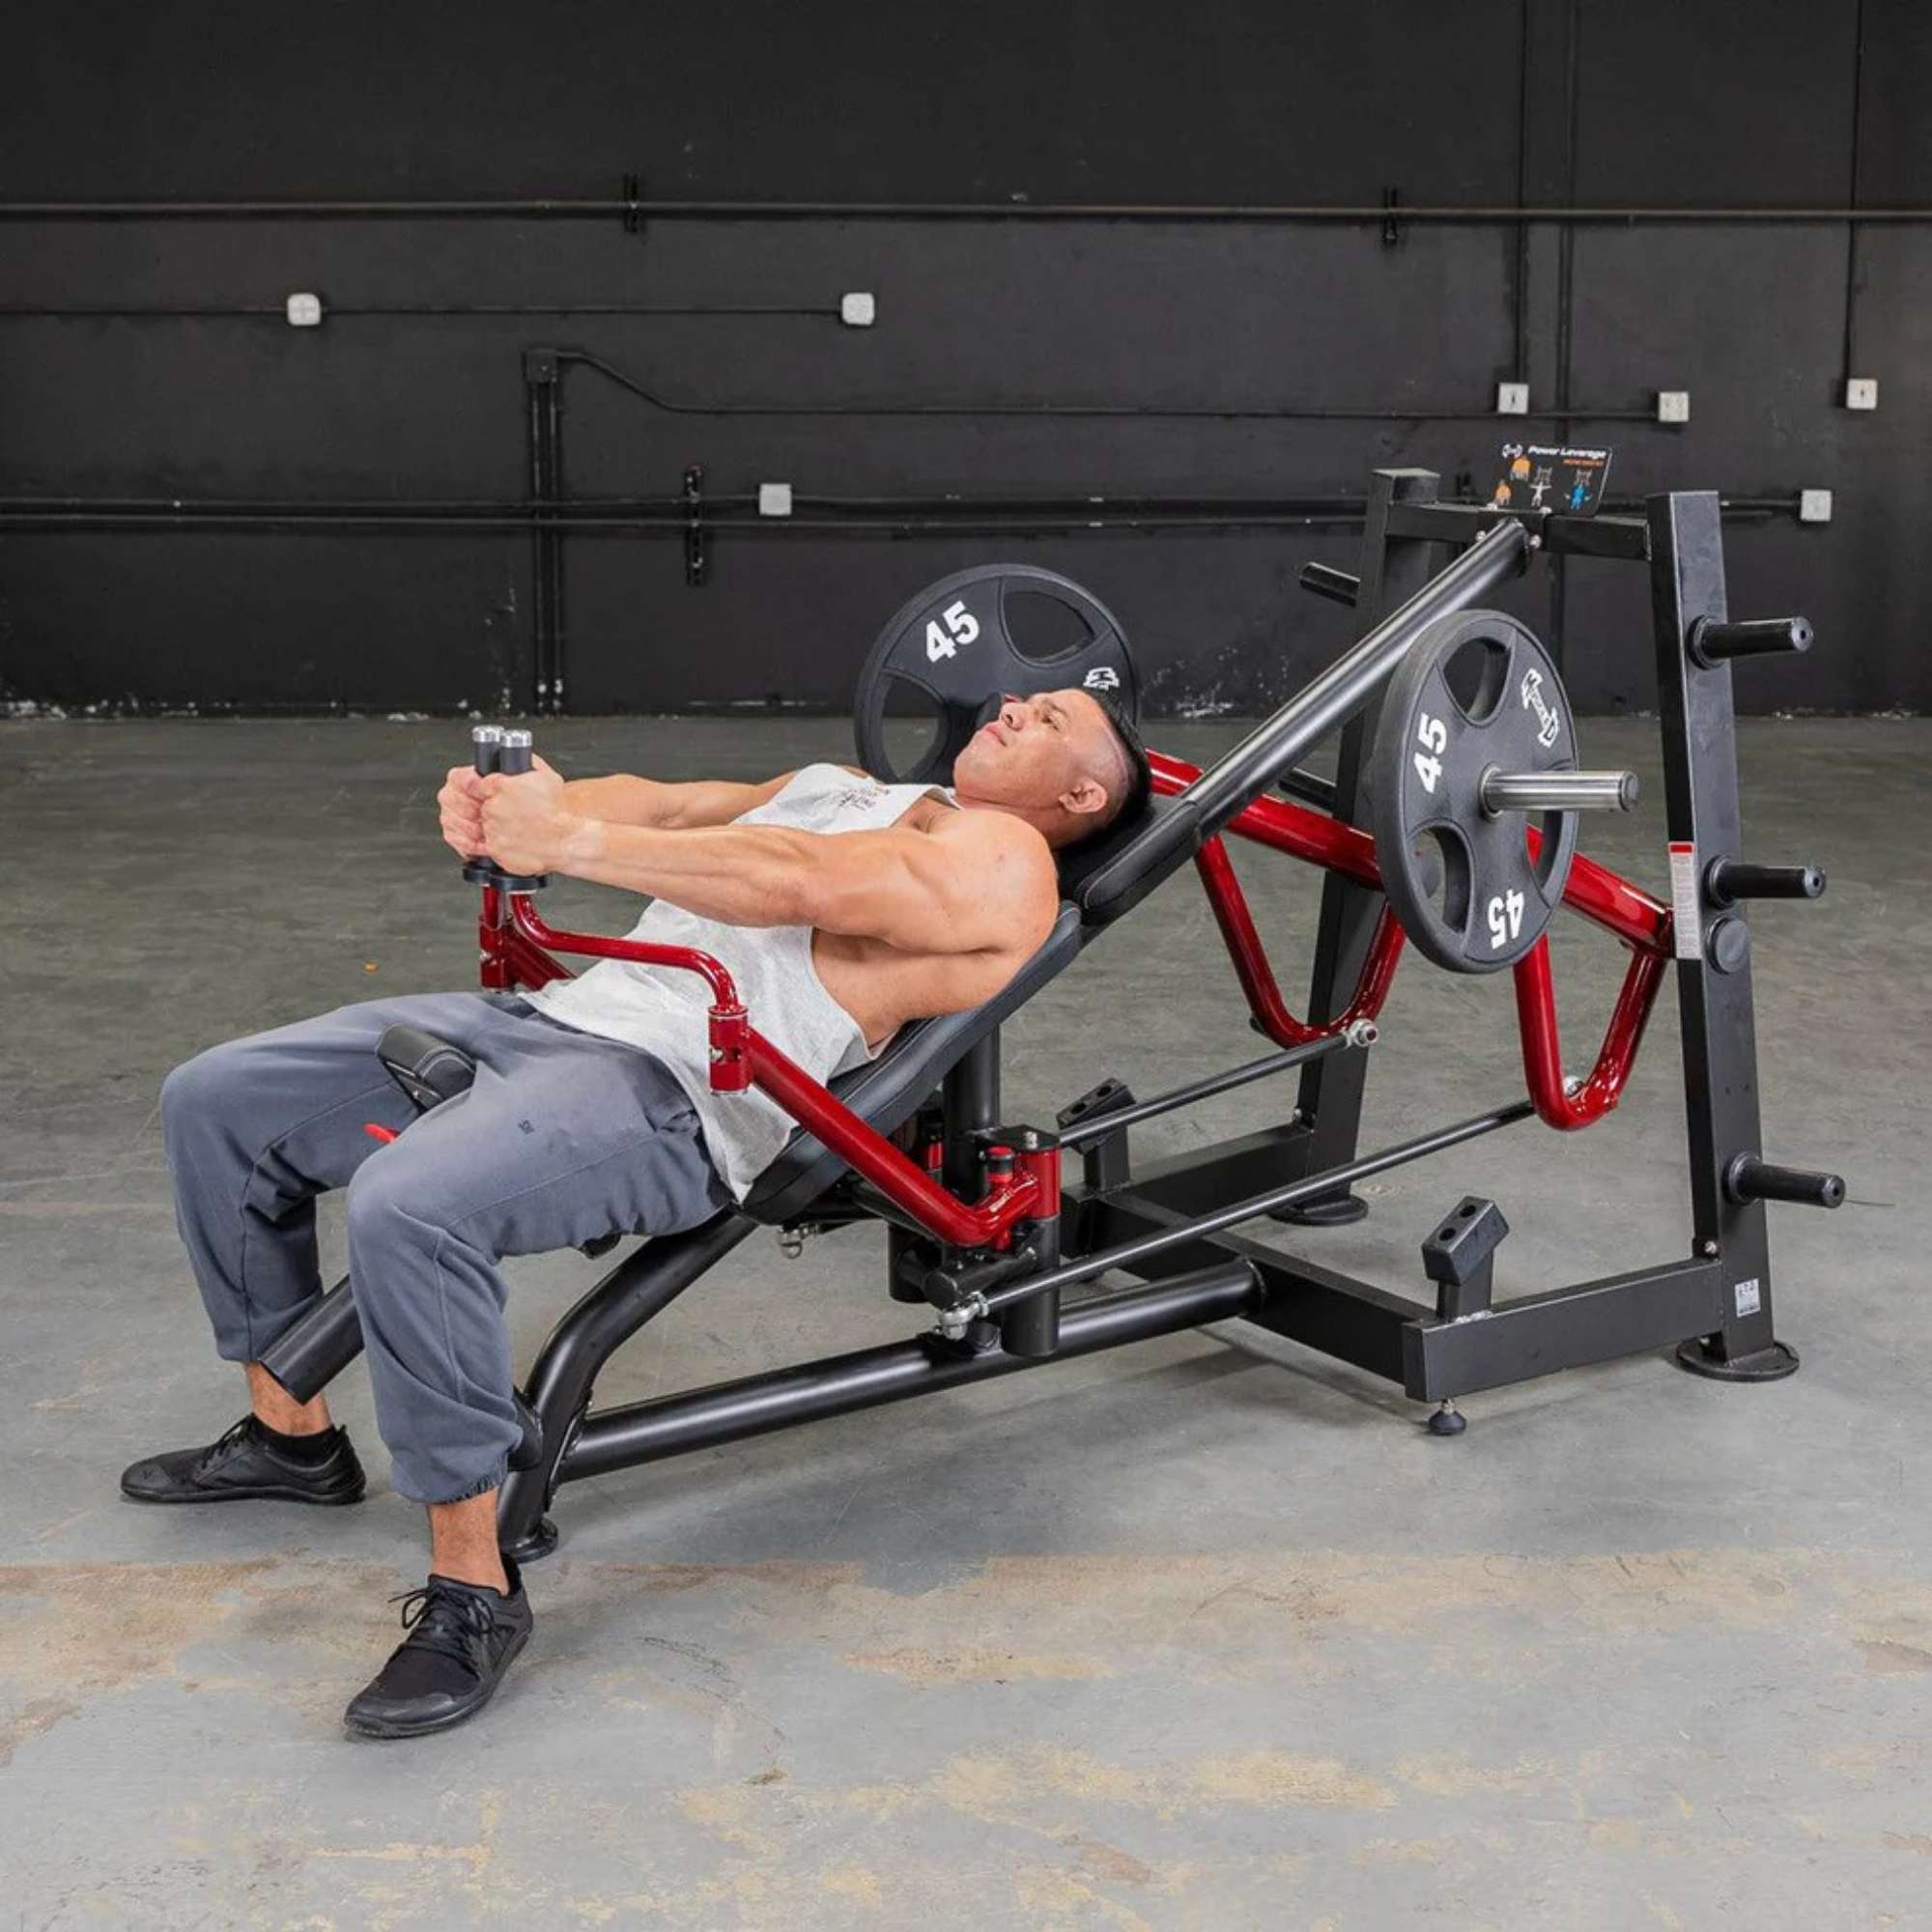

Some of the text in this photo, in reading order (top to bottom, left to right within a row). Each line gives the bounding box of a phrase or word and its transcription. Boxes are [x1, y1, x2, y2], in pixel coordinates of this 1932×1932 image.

[925, 600, 980, 663] 45
[1413, 712, 1447, 794] 45
[1488, 889, 1524, 950] 45
